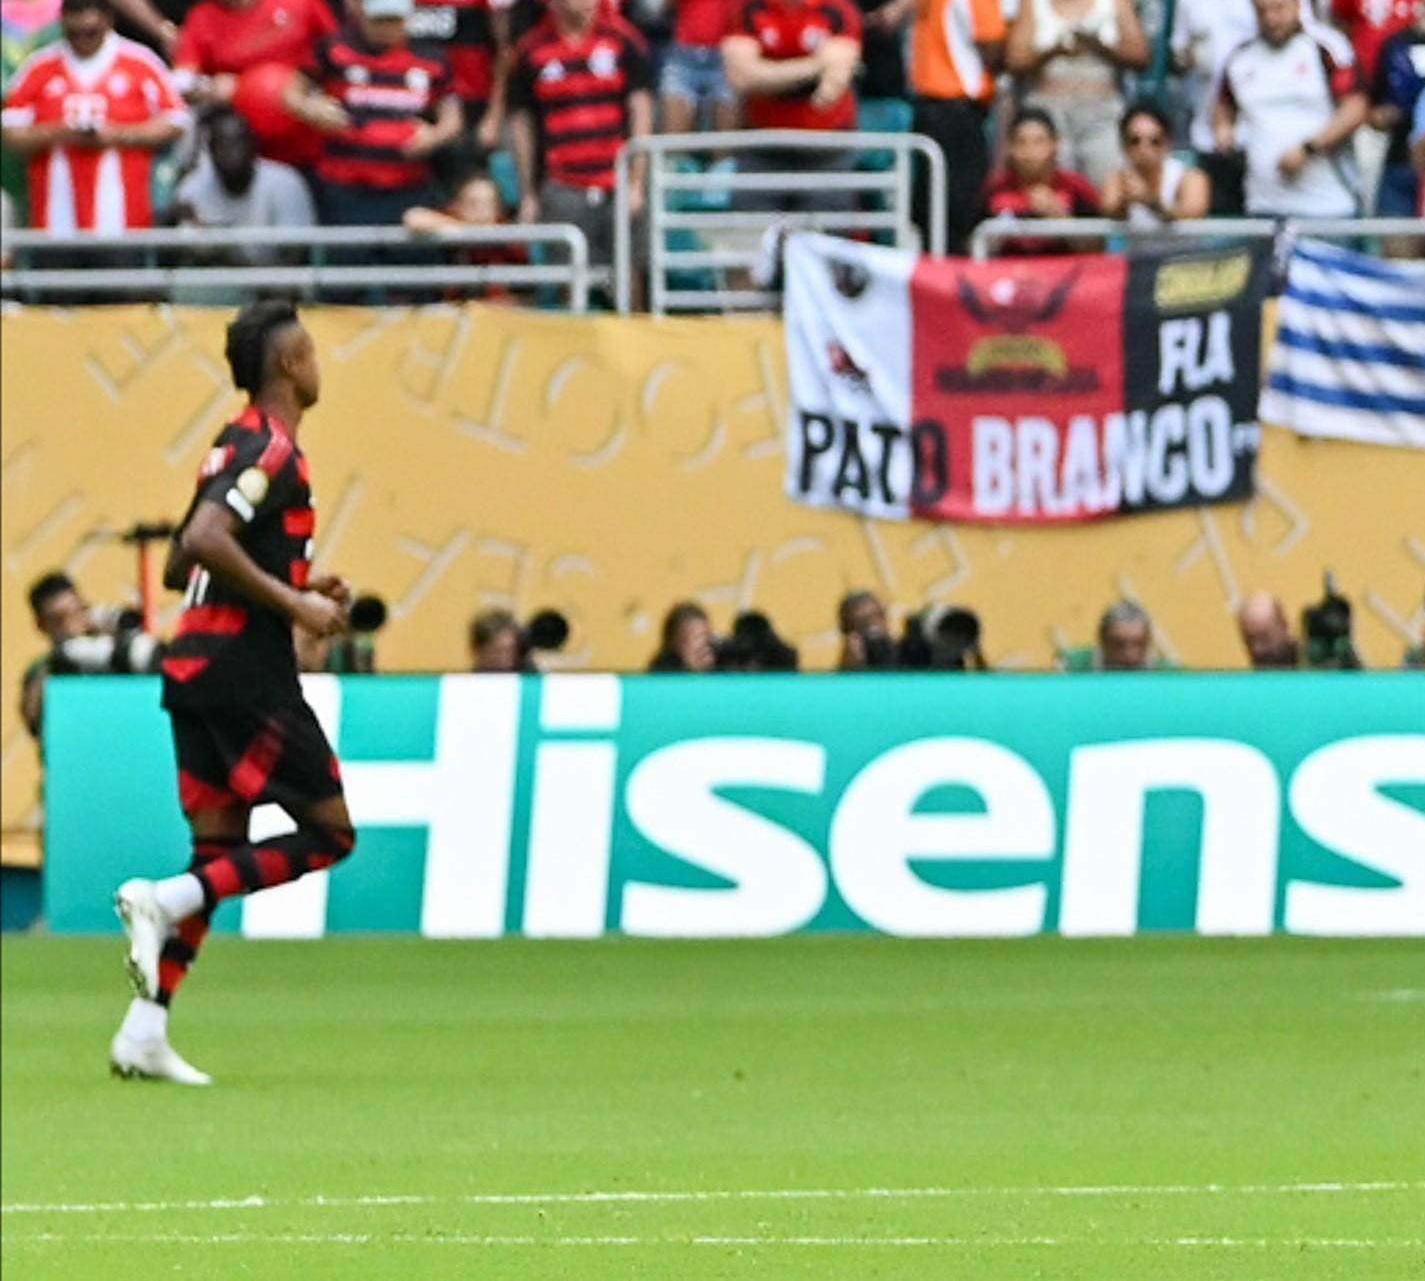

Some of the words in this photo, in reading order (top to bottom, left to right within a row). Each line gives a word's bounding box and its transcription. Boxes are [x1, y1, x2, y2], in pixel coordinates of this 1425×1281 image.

[1157, 312, 1235, 395] FLA
[800, 411, 947, 505] PATO
[971, 395, 1233, 517] BRANCO
